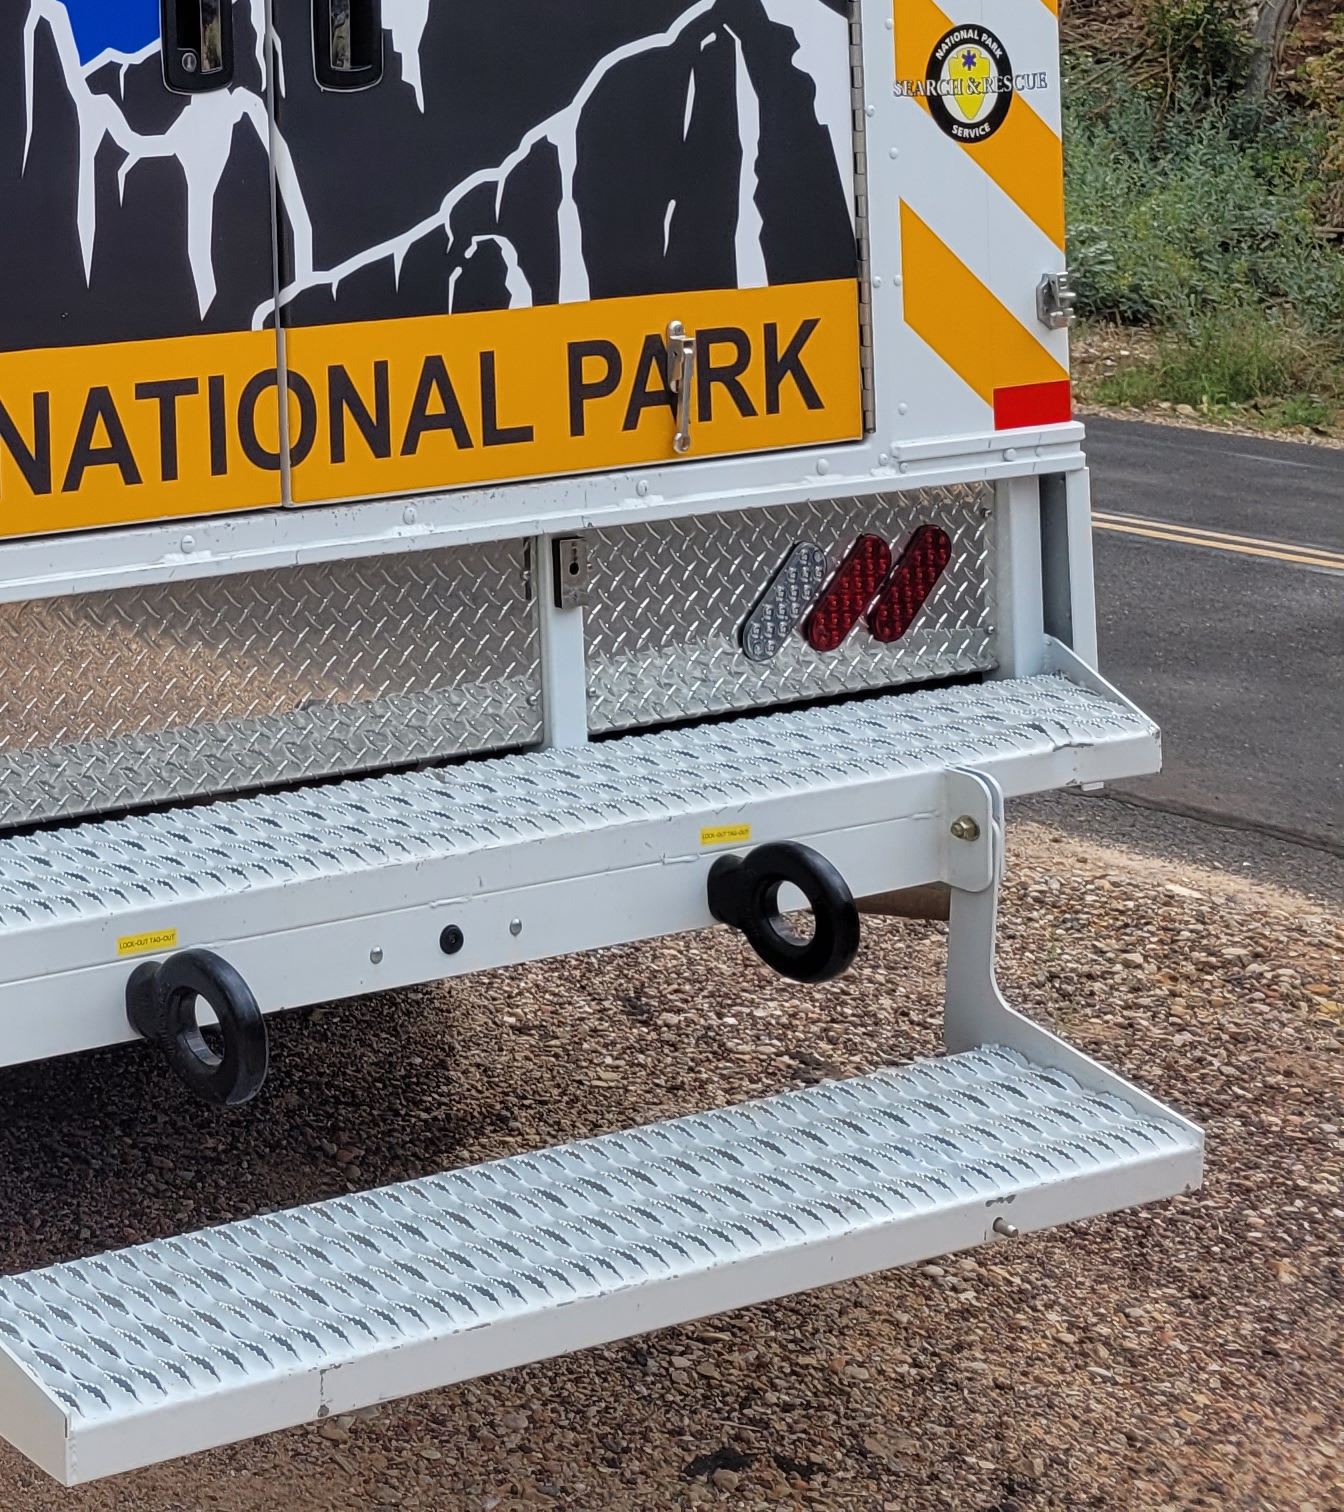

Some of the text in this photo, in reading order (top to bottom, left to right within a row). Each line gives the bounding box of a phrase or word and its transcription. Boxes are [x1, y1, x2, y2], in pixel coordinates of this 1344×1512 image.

[935, 28, 1003, 61] NATIONAL PARK
[893, 71, 1048, 98] SEARCH & RESCUE
[951, 122, 992, 139] SERVICE
[569, 318, 826, 437] PARK
